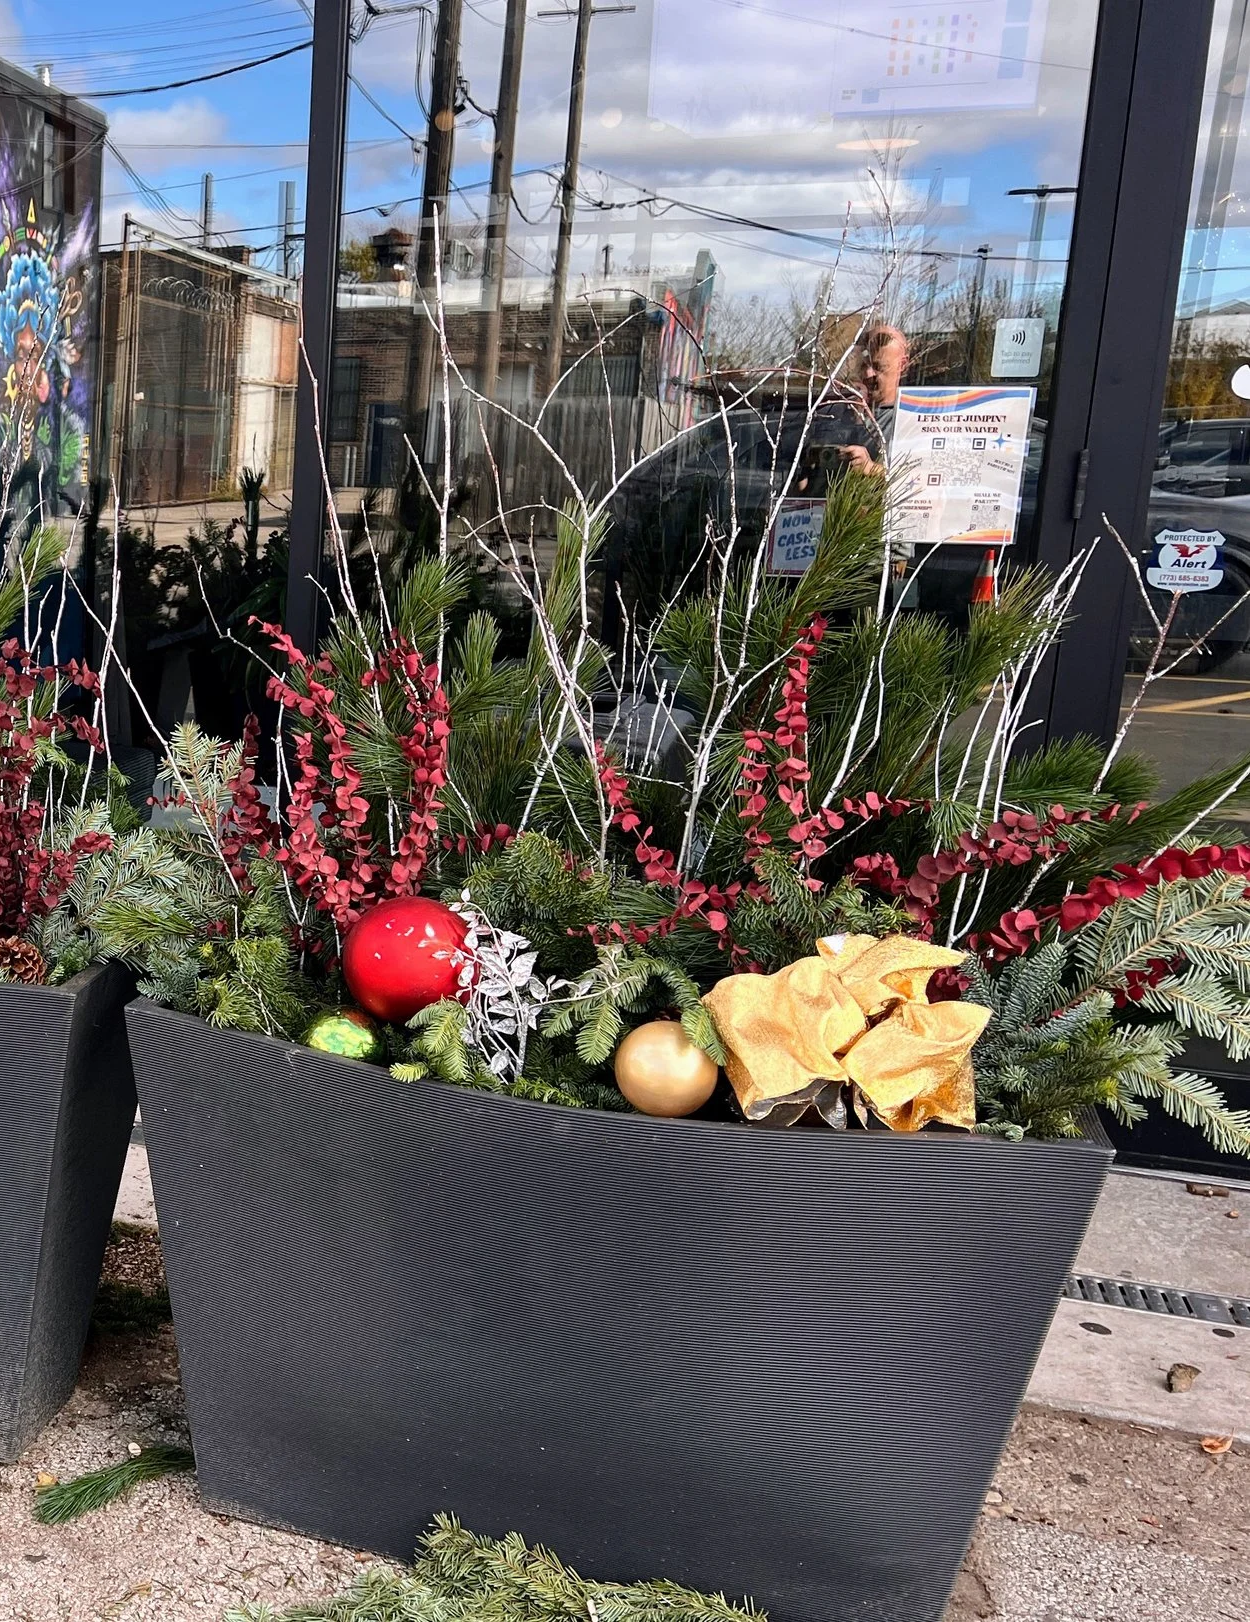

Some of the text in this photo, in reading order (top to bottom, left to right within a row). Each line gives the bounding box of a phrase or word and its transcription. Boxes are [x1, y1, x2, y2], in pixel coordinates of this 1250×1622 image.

[942, 414, 962, 423] GET
[964, 426, 999, 434] WAIVER
[782, 513, 811, 529] NOW
[1164, 534, 1205, 542] PROTECTED
[785, 545, 816, 561] LESS
[1170, 558, 1207, 568] Alert
